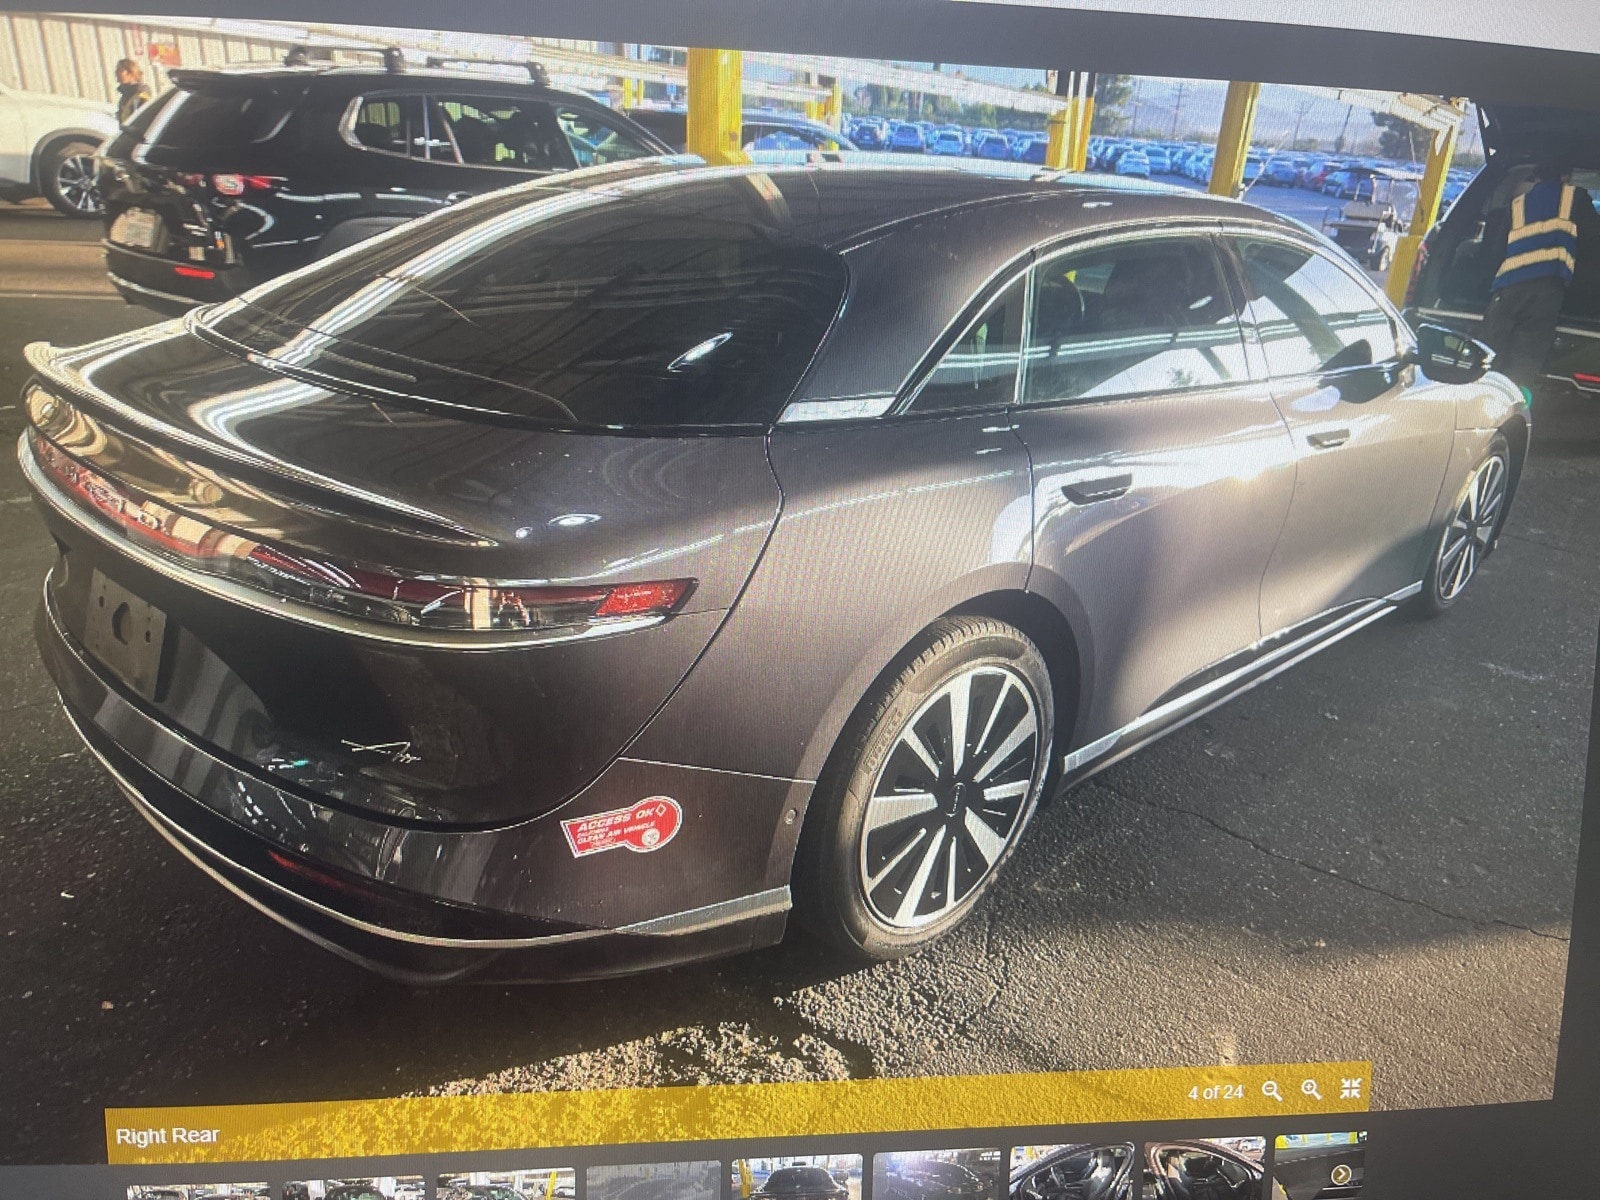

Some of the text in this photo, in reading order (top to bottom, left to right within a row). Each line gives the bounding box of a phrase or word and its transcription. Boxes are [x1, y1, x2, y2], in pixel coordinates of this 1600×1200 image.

[577, 813, 632, 833] ACCESS
[636, 807, 656, 819] OK
[1188, 1085, 1244, 1100] 4 of 24
[116, 1127, 220, 1148] Right Rear
